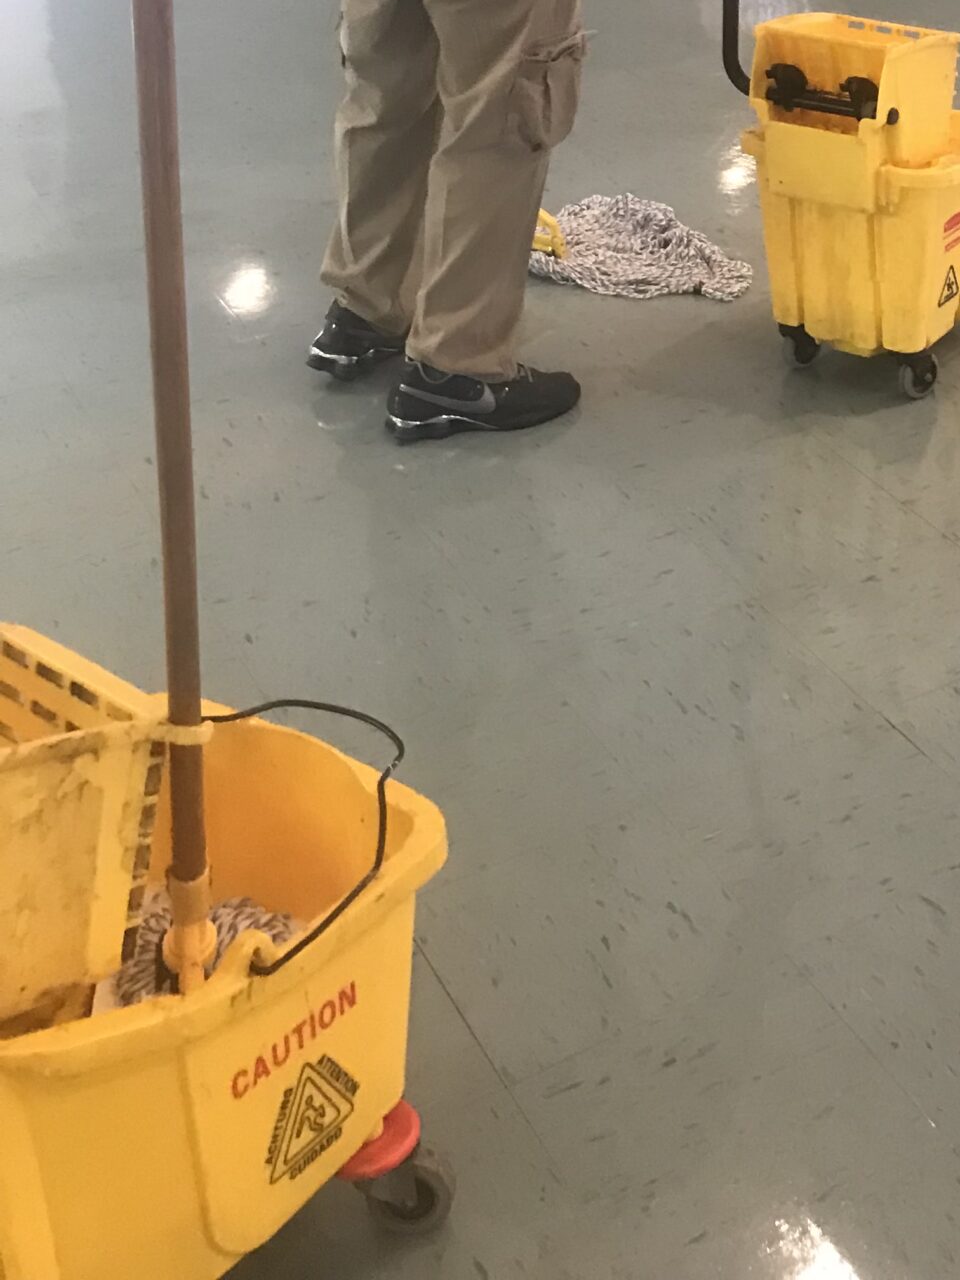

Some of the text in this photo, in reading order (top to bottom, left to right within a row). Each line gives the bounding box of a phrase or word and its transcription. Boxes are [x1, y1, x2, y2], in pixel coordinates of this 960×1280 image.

[230, 980, 357, 1100] CAUTION
[316, 1053, 360, 1097] ATTENTION
[264, 1087, 294, 1165] ACHTUNG
[288, 1126, 343, 1181] CUIDADO
